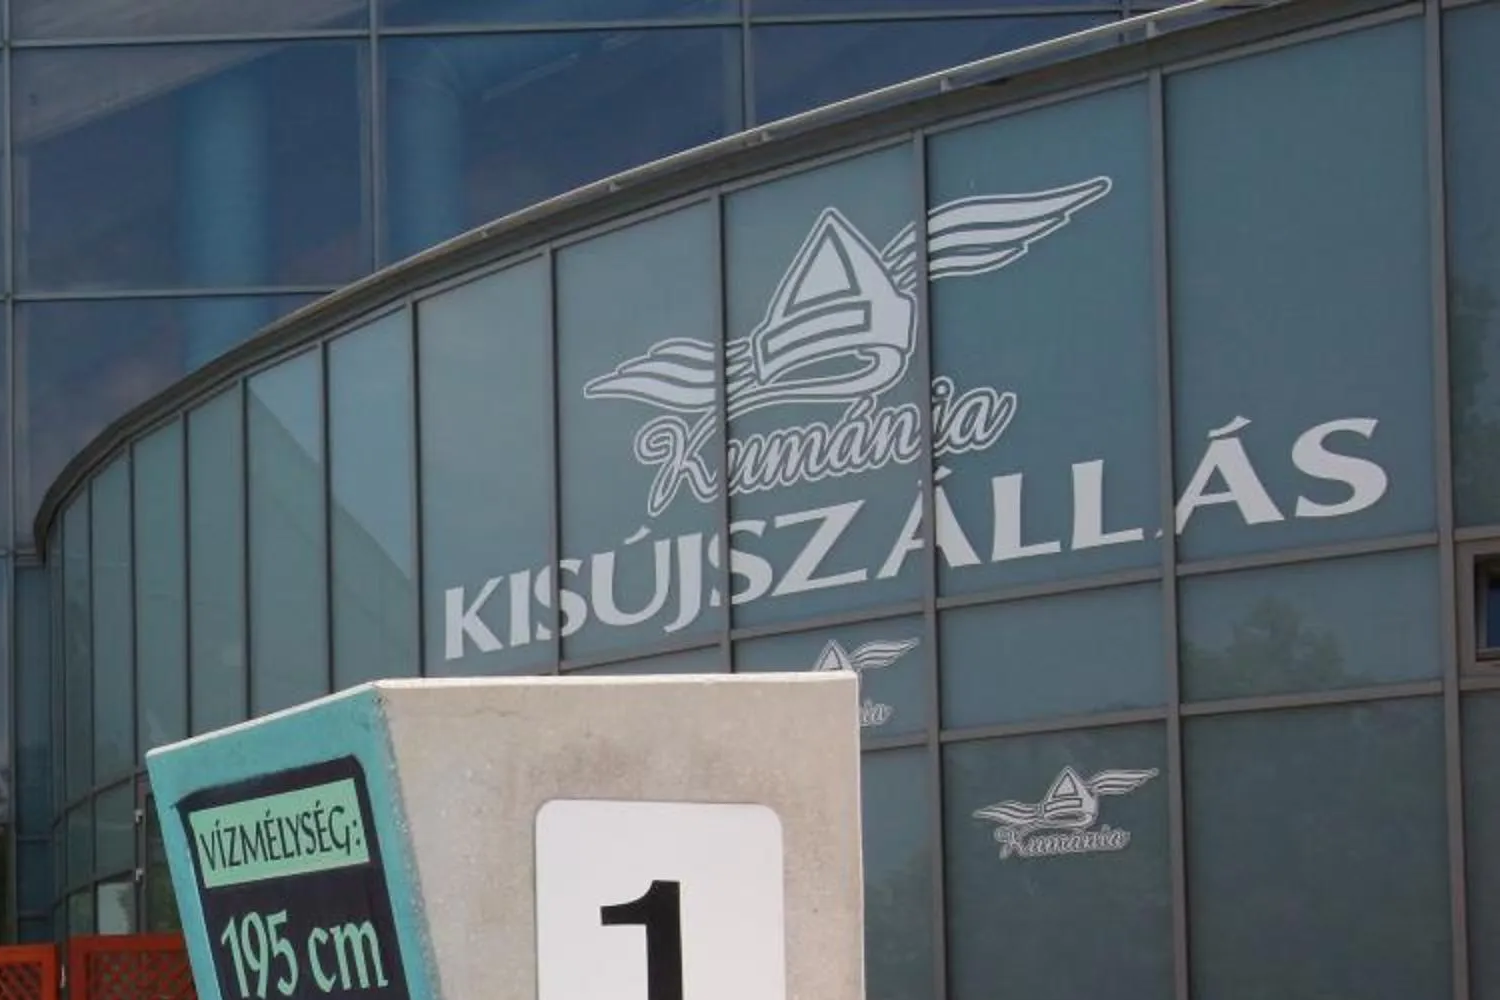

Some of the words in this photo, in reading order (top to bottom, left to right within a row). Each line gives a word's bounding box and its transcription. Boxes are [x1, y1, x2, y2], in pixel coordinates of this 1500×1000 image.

[633, 375, 1018, 516] Kumánia
[443, 415, 1390, 660] KISÚJSZÁLLÁS
[200, 799, 362, 872] VÍZMÉLYSÉG:
[220, 909, 299, 1000] 195
[306, 919, 389, 993] cm
